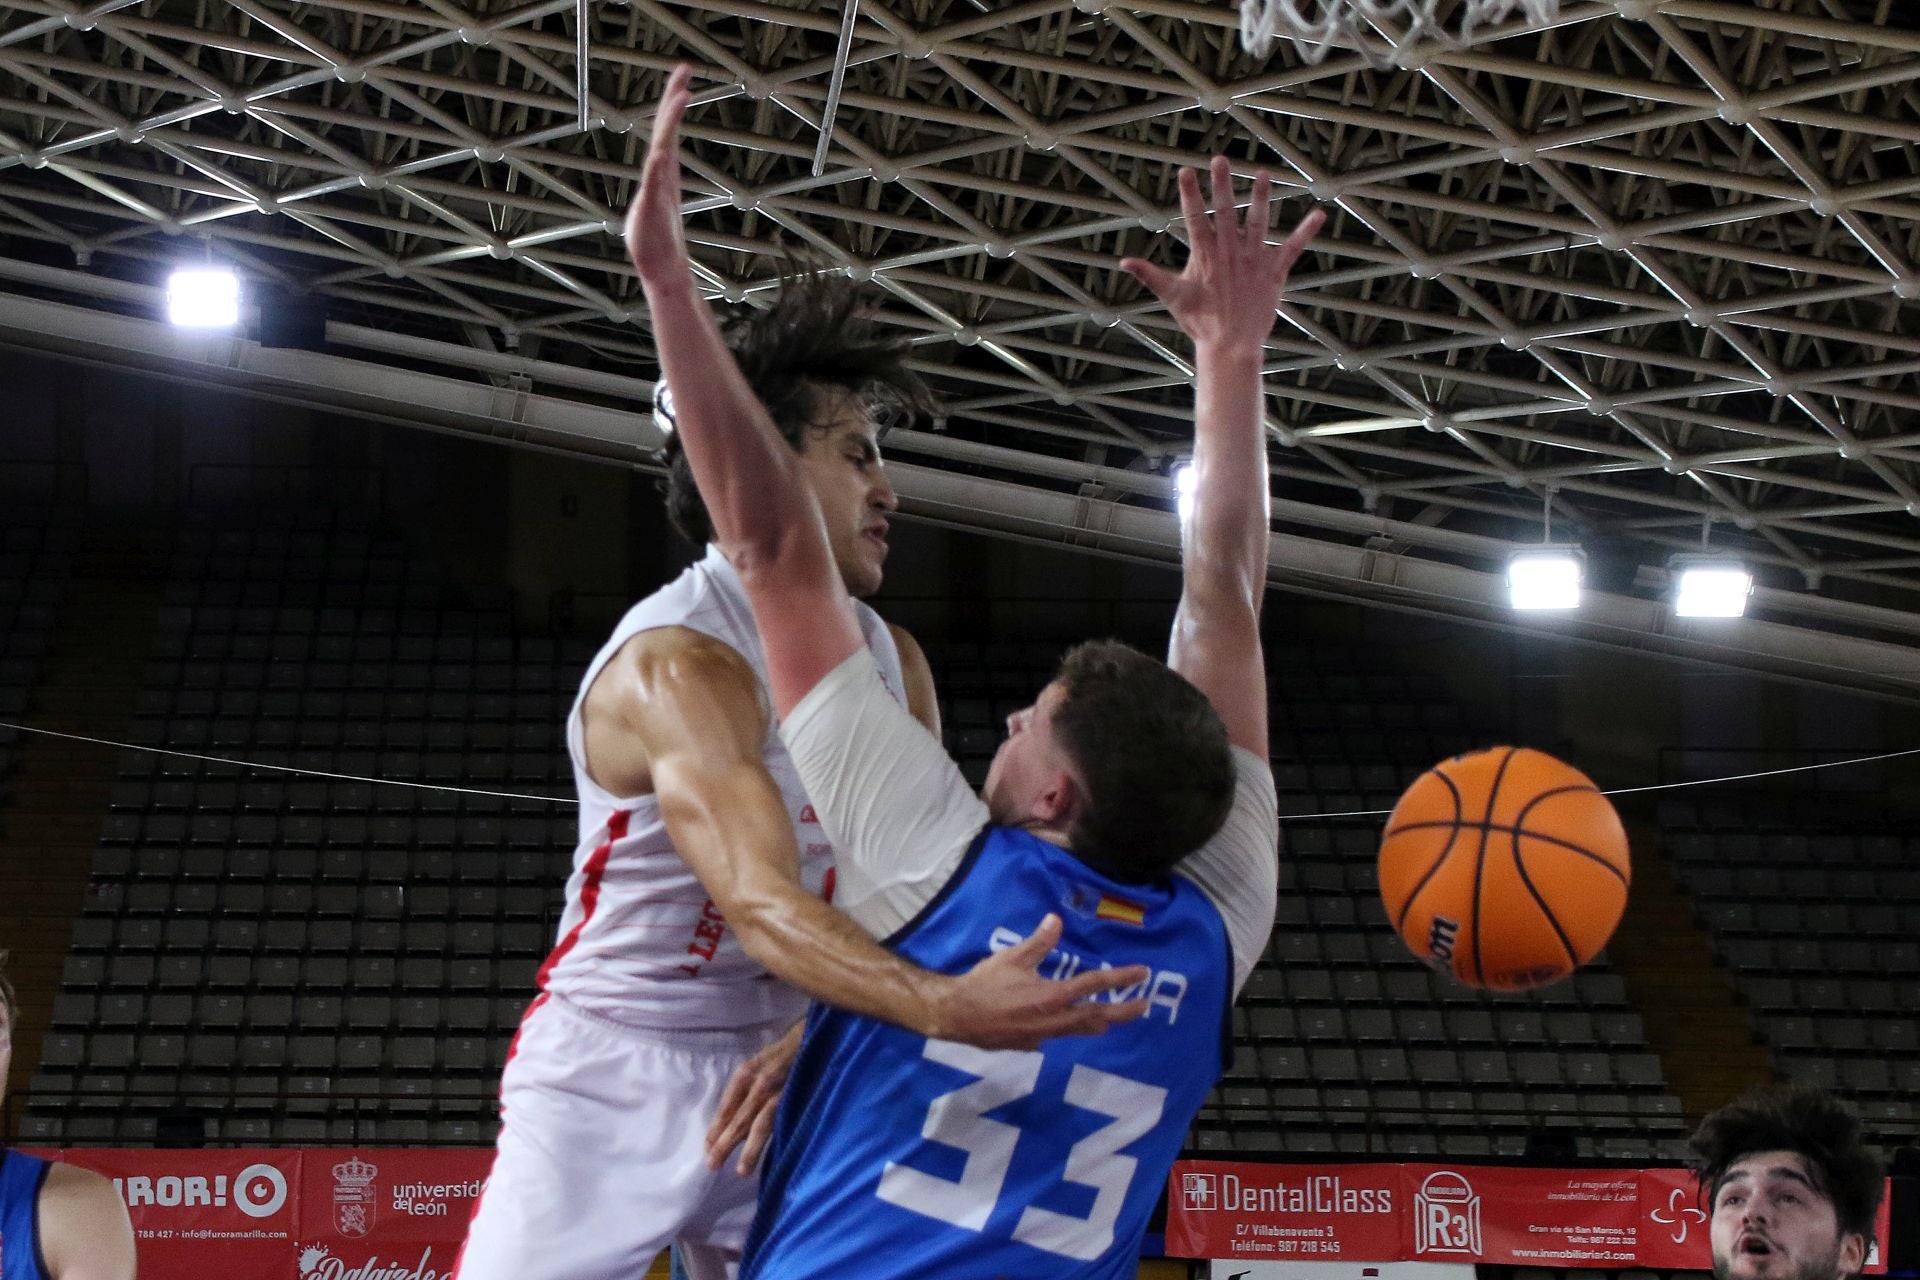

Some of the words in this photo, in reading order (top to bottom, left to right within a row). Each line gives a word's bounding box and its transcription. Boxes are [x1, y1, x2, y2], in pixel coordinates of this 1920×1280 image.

[874, 1037, 1169, 1262] 33
[393, 1181, 487, 1198] universid
[1222, 1174, 1392, 1213] DentalClass
[393, 1199, 409, 1210] de
[408, 1198, 448, 1216] león
[1236, 1224, 1250, 1236] C/
[1252, 1224, 1324, 1237] Villabenavente
[1327, 1226, 1334, 1237] 3
[1428, 1203, 1468, 1246] R3
[137, 1230, 155, 1239] 788
[157, 1230, 174, 1239] 427
[181, 1229, 288, 1240] info@furoramarillo.com
[1230, 1239, 1275, 1252] Teléfono:
[1279, 1241, 1297, 1252] 987
[1301, 1241, 1318, 1252] 218
[1320, 1241, 1340, 1253] 545
[1511, 1248, 1635, 1260] www.inmobiliariar3.com
